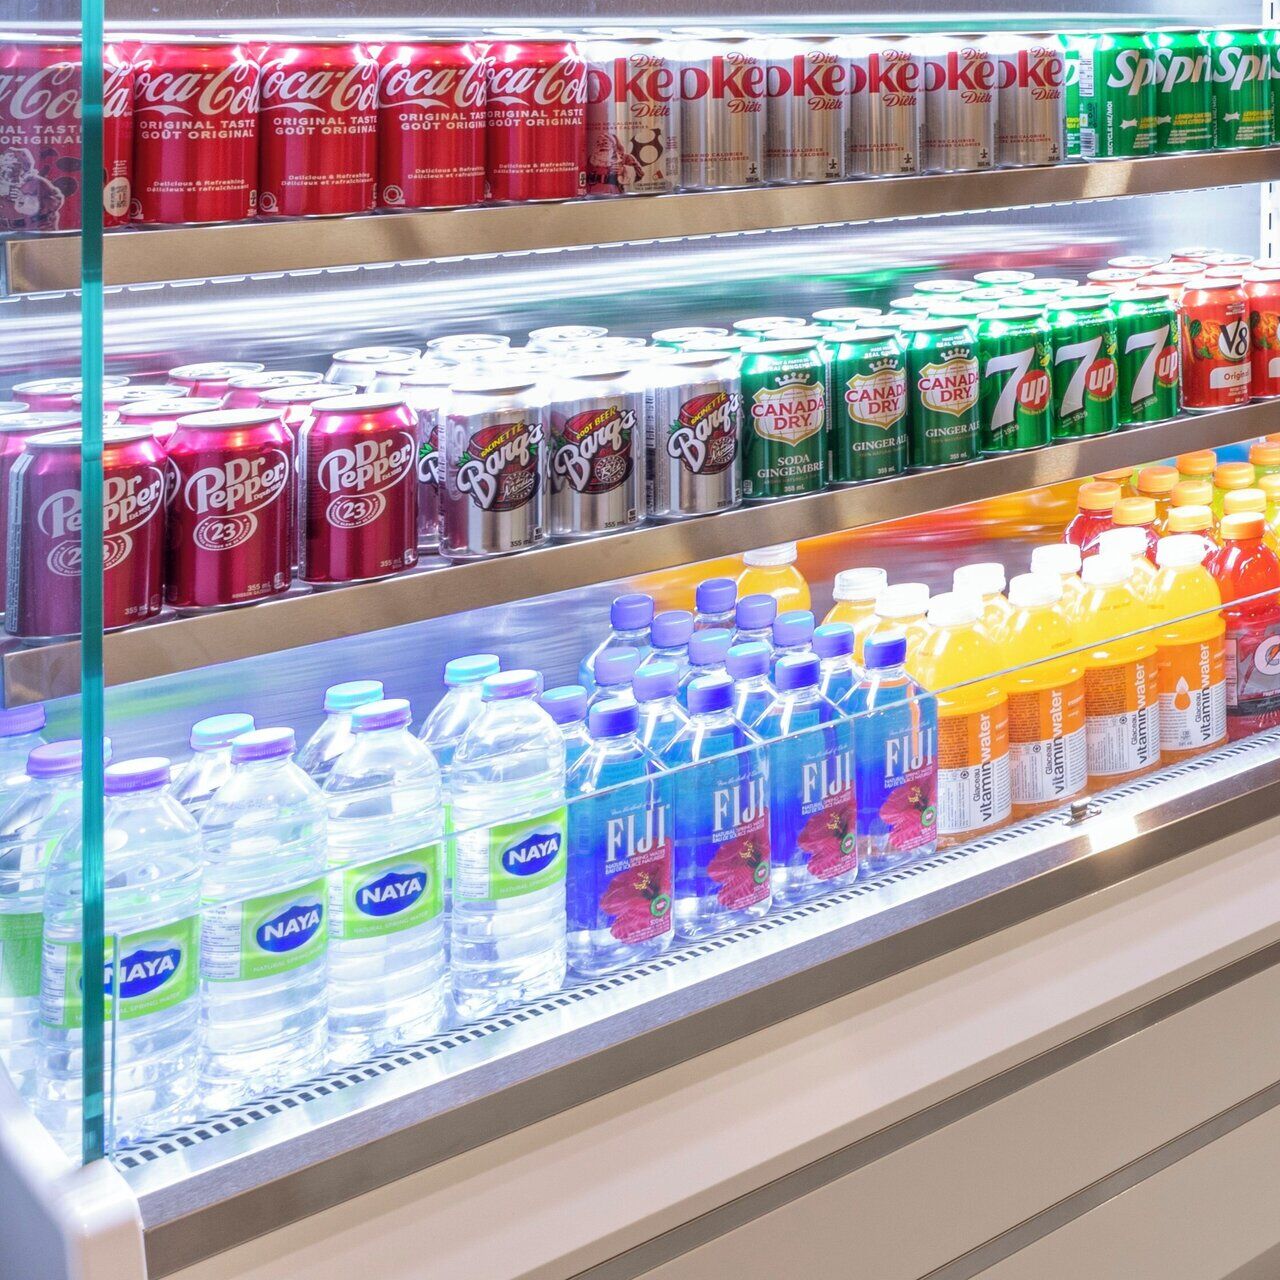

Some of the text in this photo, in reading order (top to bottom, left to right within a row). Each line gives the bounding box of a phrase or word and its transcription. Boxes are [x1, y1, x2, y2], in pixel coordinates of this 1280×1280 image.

[629, 52, 666, 69] Diet
[726, 51, 759, 67] Diet
[807, 51, 840, 65] Diet
[881, 49, 913, 64] Diet
[960, 48, 990, 62] Diet
[1030, 46, 1057, 60] Diet
[808, 96, 844, 111] Diète
[883, 93, 917, 108] Diète
[961, 90, 993, 105] Diète
[1031, 88, 1062, 101] Diète
[487, 108, 584, 119] ORIGINAL TASTE
[630, 103, 671, 119] Diète
[727, 97, 763, 114] Diète
[139, 119, 256, 130] ORIGINAL TASTE
[273, 115, 378, 126] ORIGINAL TASTE
[399, 112, 467, 122] ORIGINAL
[400, 120, 441, 131] GOÛT
[488, 116, 583, 127] GOÛT ORIGINAL
[141, 129, 255, 140] GOÛT ORIGINAL
[275, 124, 377, 136] GOÛT ORIGINAL
[1219, 316, 1248, 357] V8
[1124, 325, 1170, 404] 7
[1054, 336, 1102, 418] 7
[1089, 362, 1115, 391] up
[940, 386, 972, 402] DRY.
[985, 347, 1035, 431] 7
[1021, 378, 1049, 405] up
[751, 398, 825, 418] CANADA
[868, 397, 901, 414] DRY.
[595, 405, 617, 426] BEER
[773, 413, 813, 430] DRY.
[480, 420, 526, 459] RACINETTE
[667, 394, 740, 474] Barq's
[925, 424, 965, 438] GINGER
[354, 439, 393, 466] Dr
[554, 408, 637, 492] Barq's
[852, 438, 893, 452] GINGER
[325, 443, 411, 493] Pepper
[456, 424, 544, 511] Barq's
[757, 460, 825, 479] GINGEMBRE
[777, 454, 810, 466] SODA
[225, 458, 265, 486] Dr
[188, 466, 286, 513] Pepper
[341, 501, 368, 519] 23
[212, 524, 237, 543] 23
[1199, 643, 1211, 742] vitaminwater
[1135, 663, 1147, 765] vitaminwater
[1054, 689, 1064, 795] vitaminwater
[884, 728, 934, 779] FIJI
[981, 712, 992, 823] vitaminwater
[802, 751, 852, 805] FIJI
[713, 777, 766, 833] FIJI
[605, 804, 667, 863] FIJI
[507, 838, 559, 866] NAYA
[361, 877, 423, 905] NAYA
[263, 909, 320, 942] NAYA
